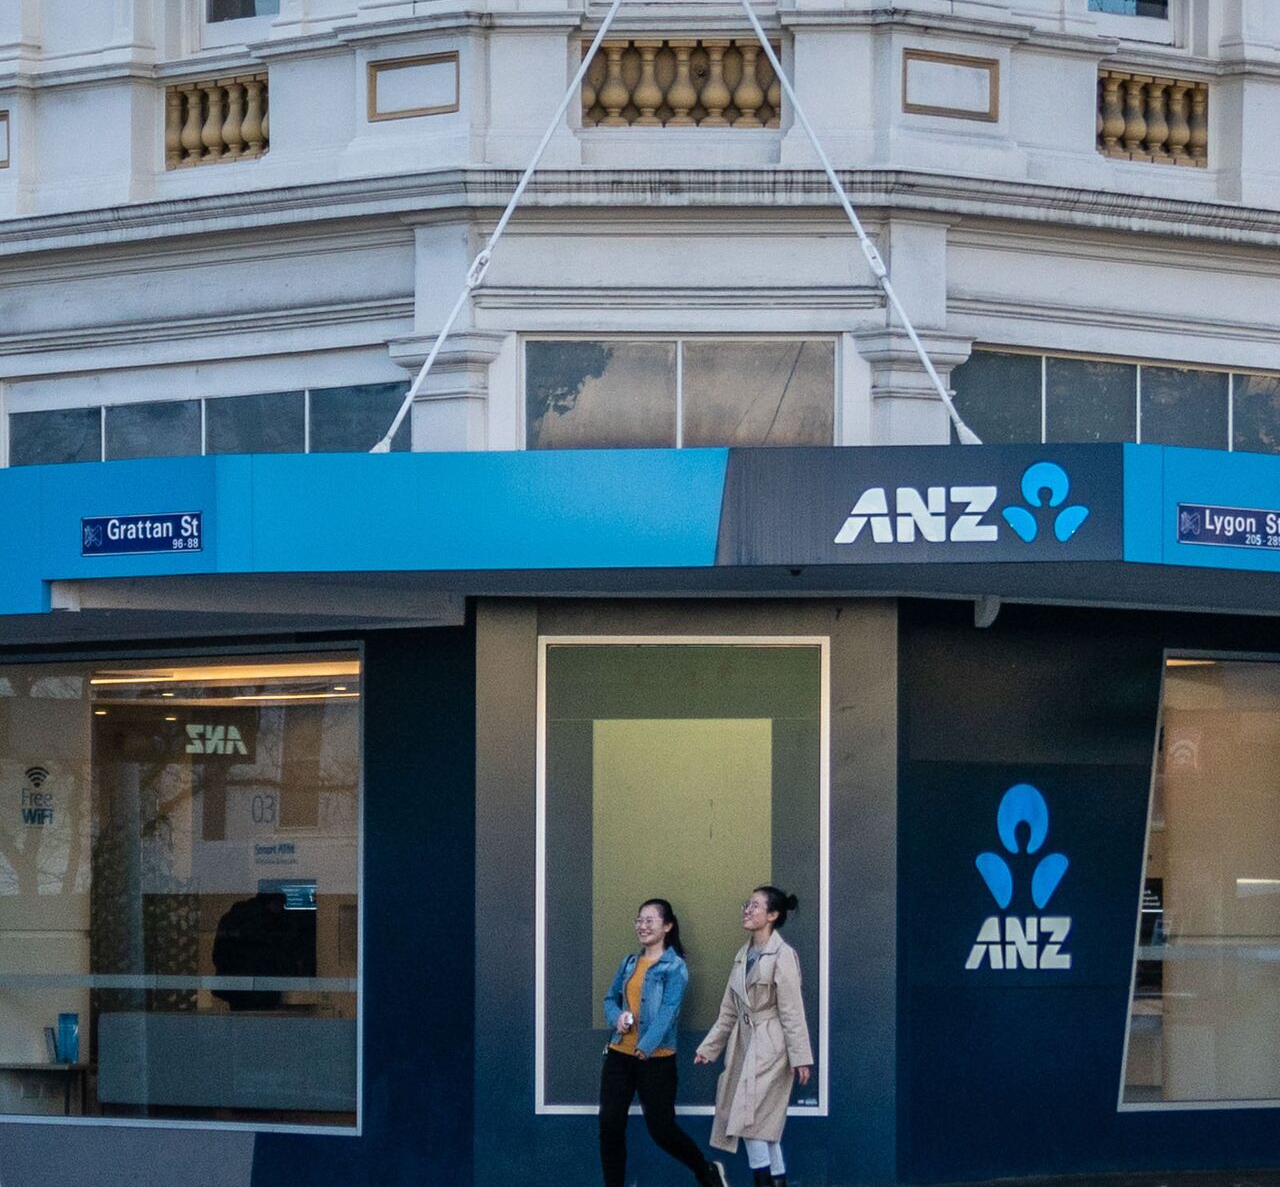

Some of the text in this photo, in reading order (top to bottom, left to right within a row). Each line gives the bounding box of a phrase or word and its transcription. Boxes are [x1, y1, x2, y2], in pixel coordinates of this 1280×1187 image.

[107, 515, 199, 540] Grattan St
[833, 486, 998, 543] ANZ
[1205, 509, 1256, 536] Lygon
[172, 538, 199, 549] 96-88
[22, 788, 53, 806] Free
[965, 916, 1072, 969] ANZ
